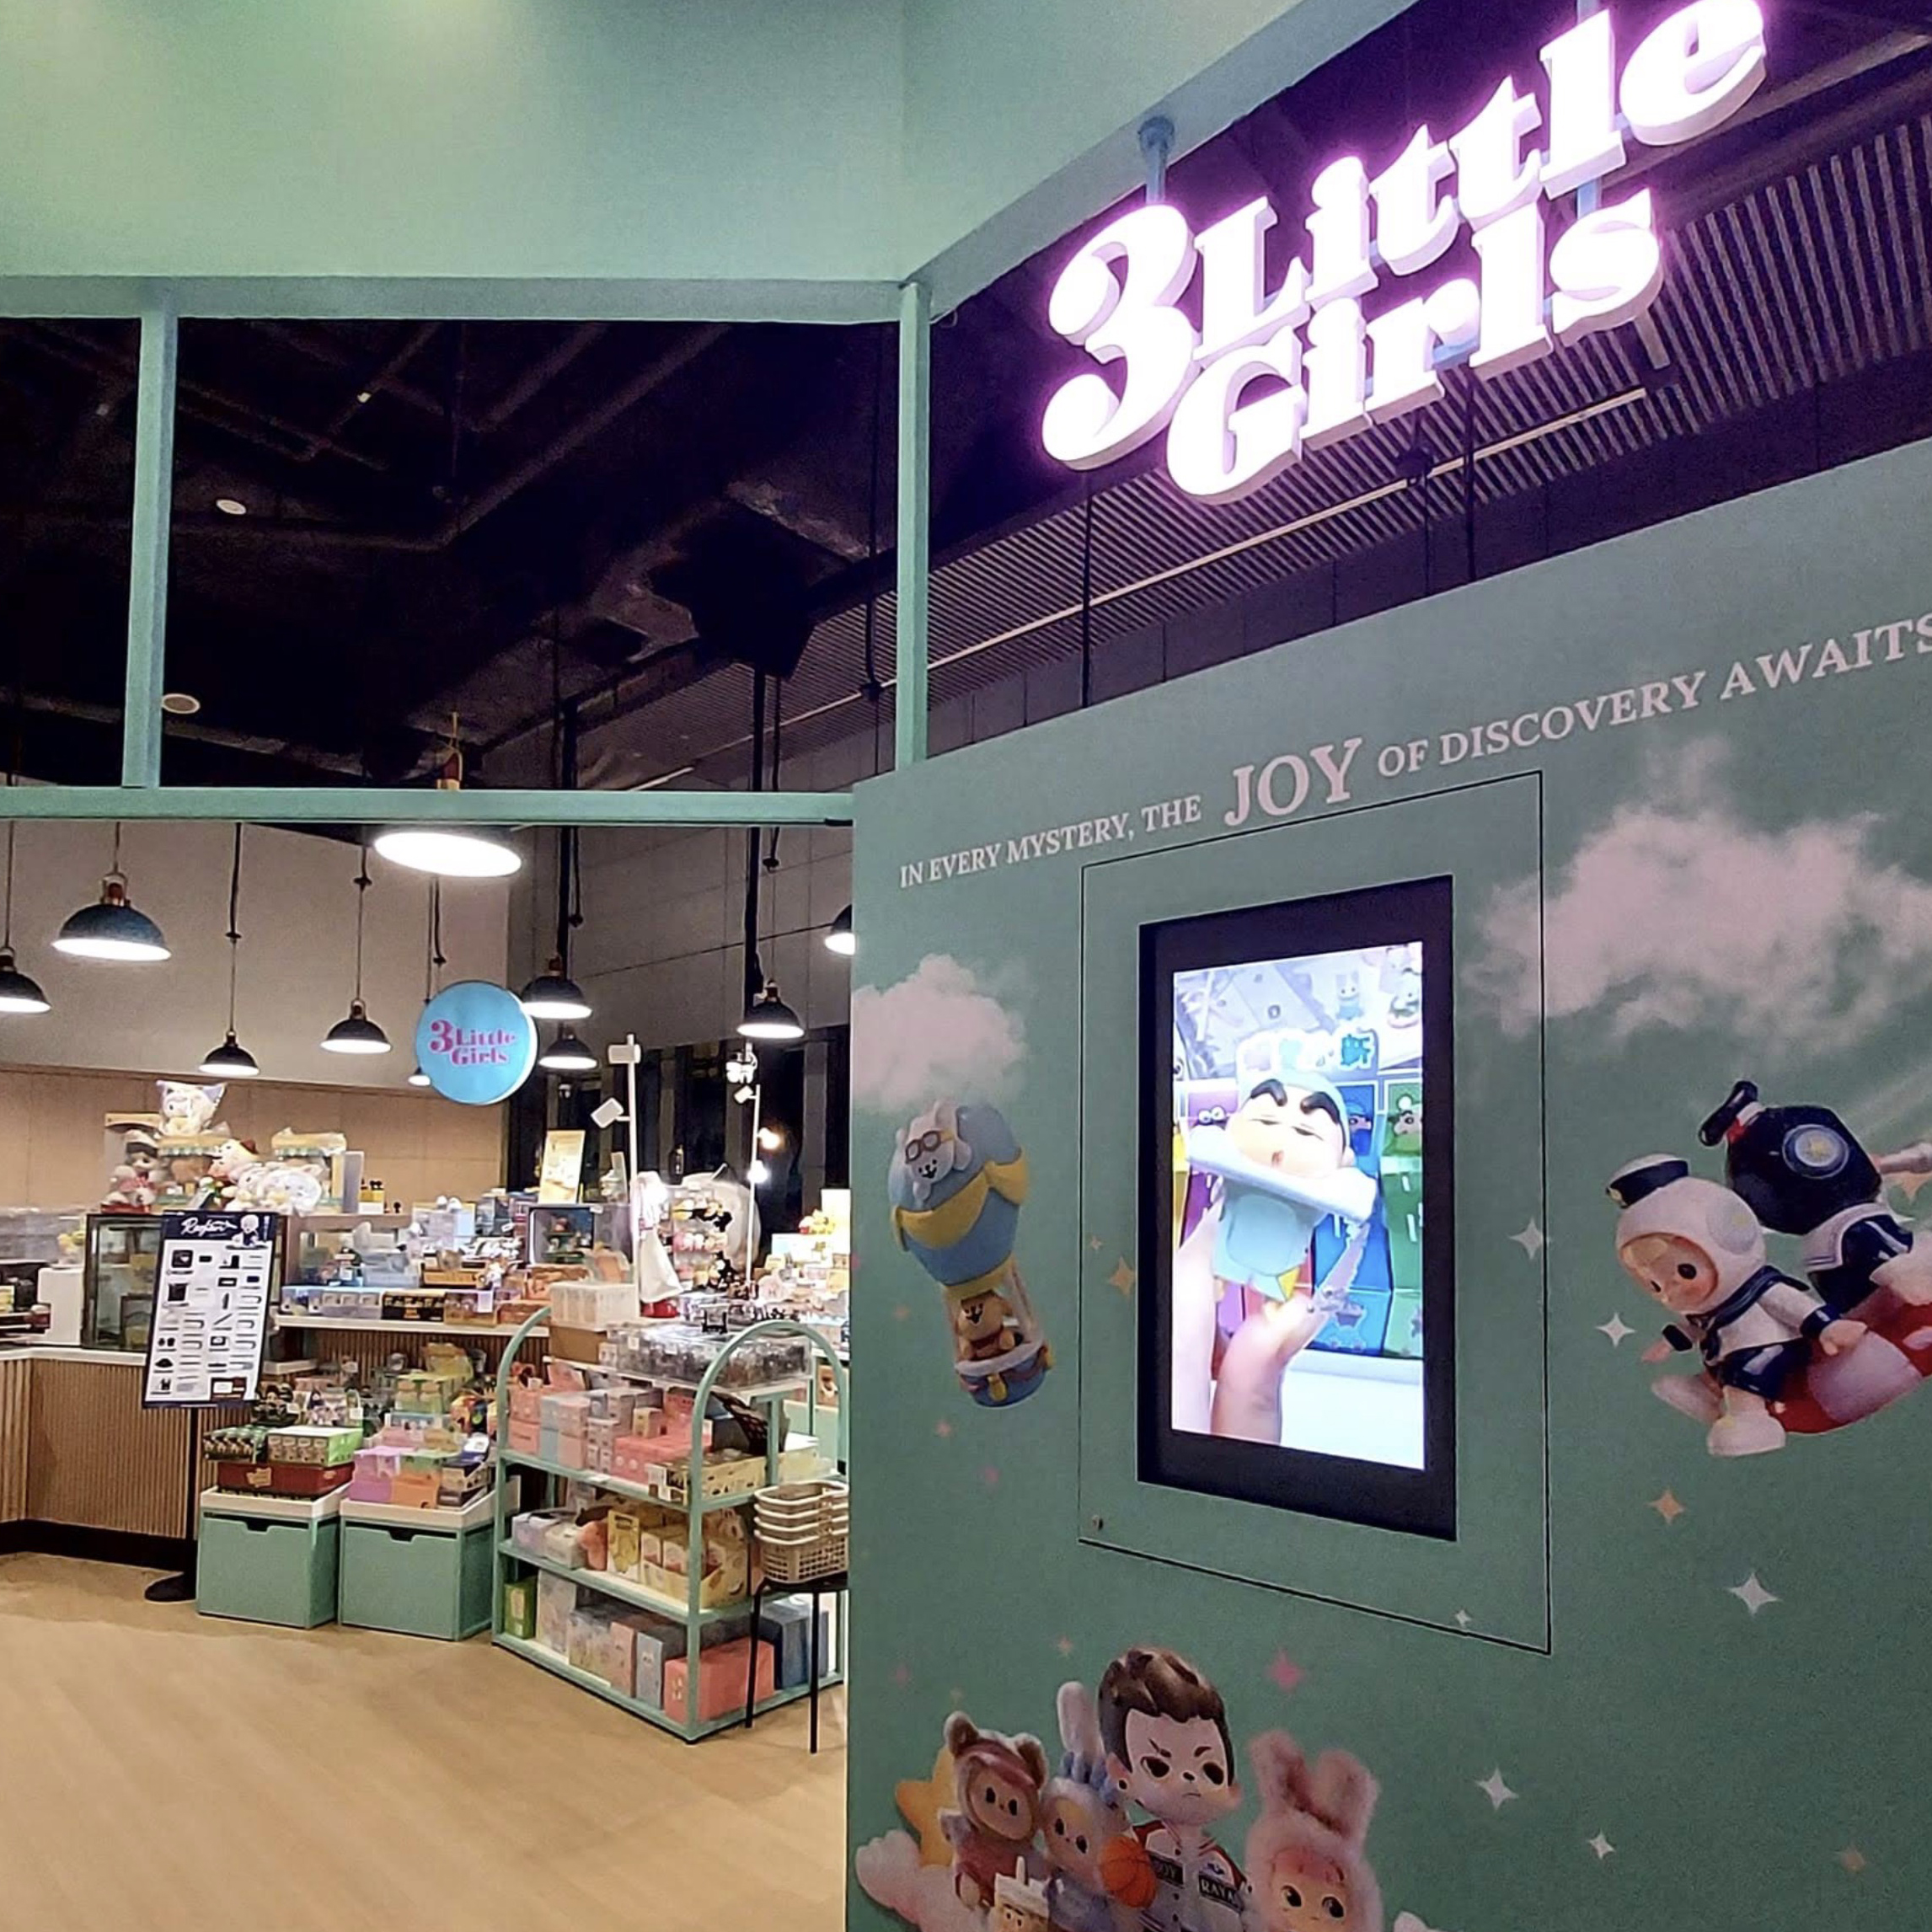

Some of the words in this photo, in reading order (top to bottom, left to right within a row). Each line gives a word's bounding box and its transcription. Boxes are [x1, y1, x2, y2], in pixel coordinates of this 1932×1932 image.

[1042, 205, 1197, 469] 3
[1194, 0, 1767, 360] Little
[1166, 190, 1663, 503] Girls
[899, 861, 926, 889] IN
[928, 843, 1002, 882] EVERY
[1007, 813, 1135, 864] MYSTERY,
[1141, 795, 1202, 833] THE
[1224, 738, 1362, 827] JOY
[1378, 741, 1430, 778] OF
[1439, 672, 1706, 766] DISCOVERY
[430, 1020, 453, 1052] 3
[451, 1047, 507, 1065] Girls
